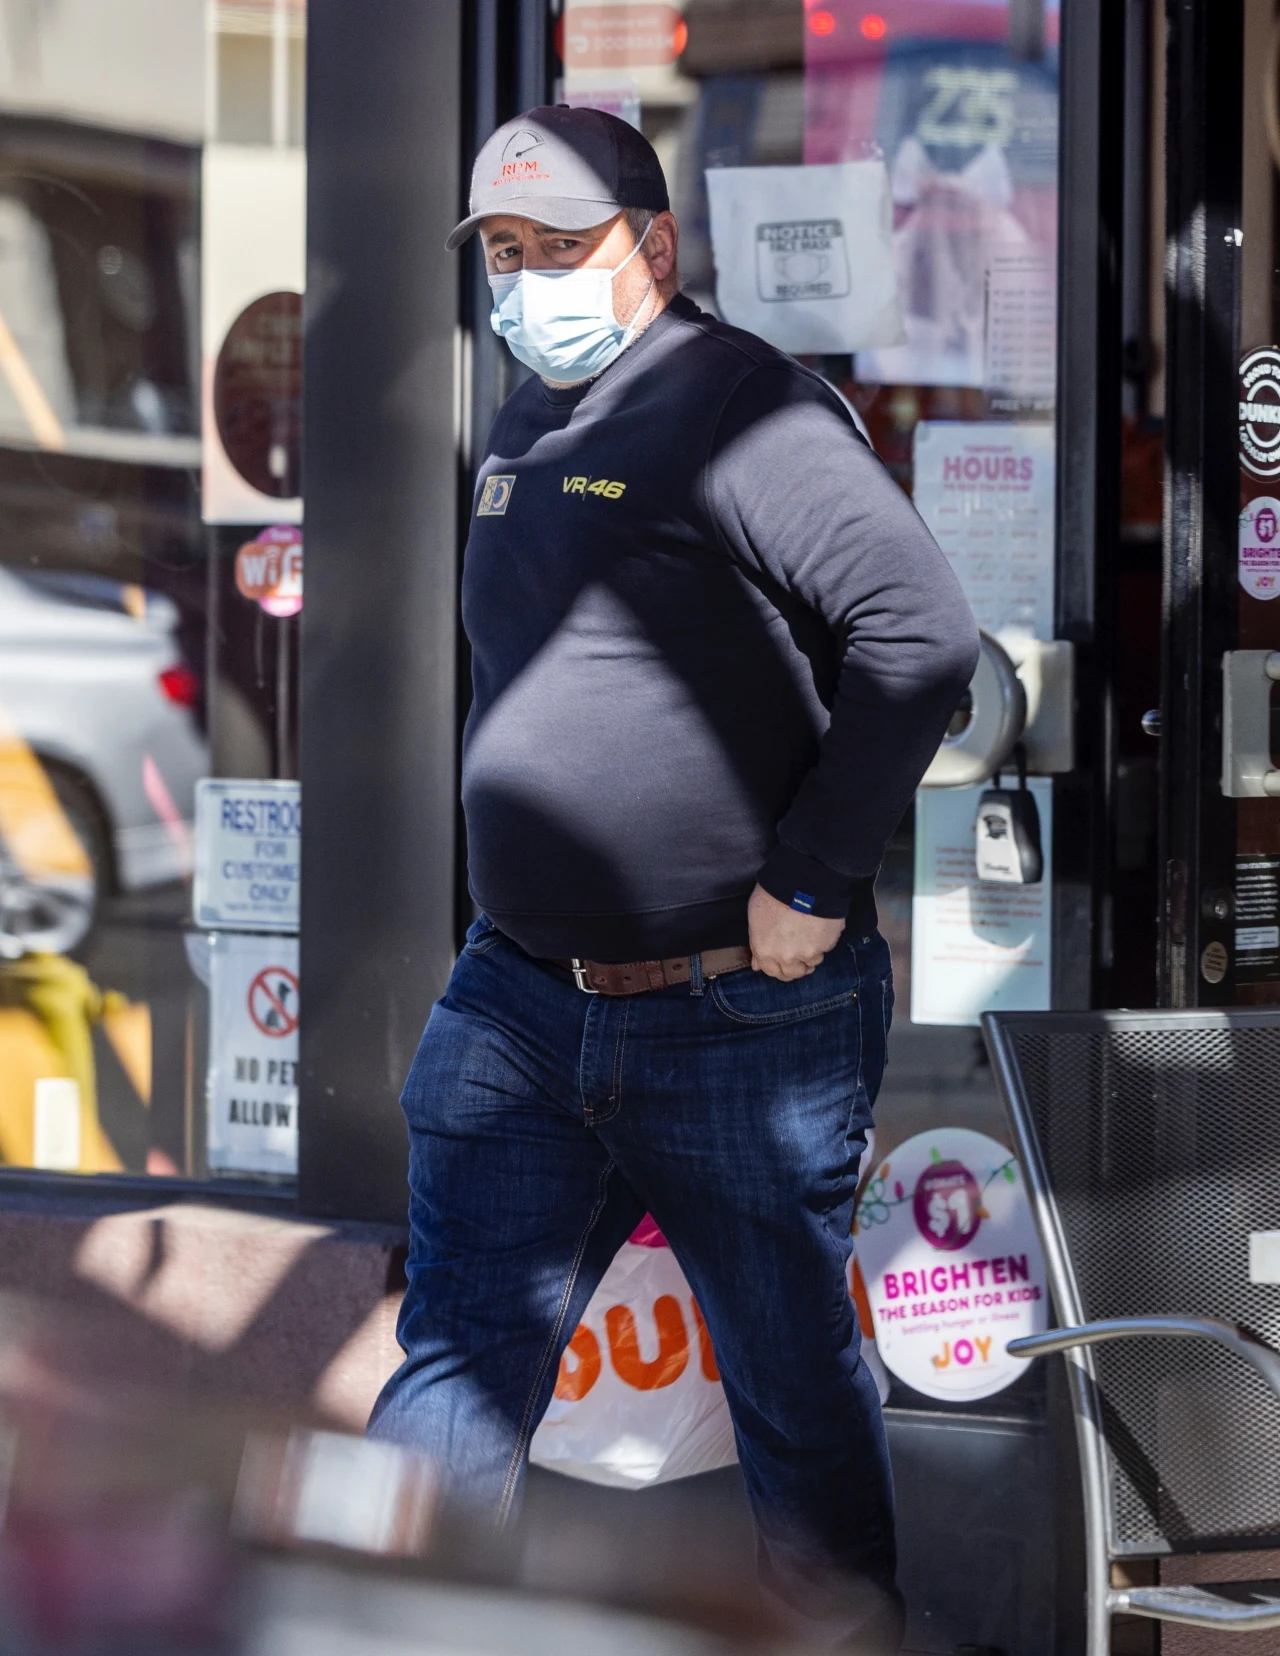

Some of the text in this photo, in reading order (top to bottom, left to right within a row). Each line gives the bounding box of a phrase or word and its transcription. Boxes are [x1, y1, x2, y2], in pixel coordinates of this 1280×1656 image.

[503, 161, 538, 177] RPM
[763, 223, 834, 241] NOTICE
[770, 239, 831, 253] FACE MASK
[776, 283, 833, 297] REQUIRED
[1243, 363, 1271, 388] PROUD
[943, 456, 1033, 482] HOURS
[255, 841, 287, 858] FOR
[249, 884, 291, 902] ONLY
[235, 1057, 259, 1083] NO
[924, 1175, 966, 1190] DONATE
[928, 1189, 971, 1238] $1
[884, 1255, 1029, 1298] BRIGHTEN
[878, 1286, 1042, 1322] THE SEASON FOR KIDS
[943, 1317, 975, 1330] hunger
[932, 1335, 992, 1369] JOY
